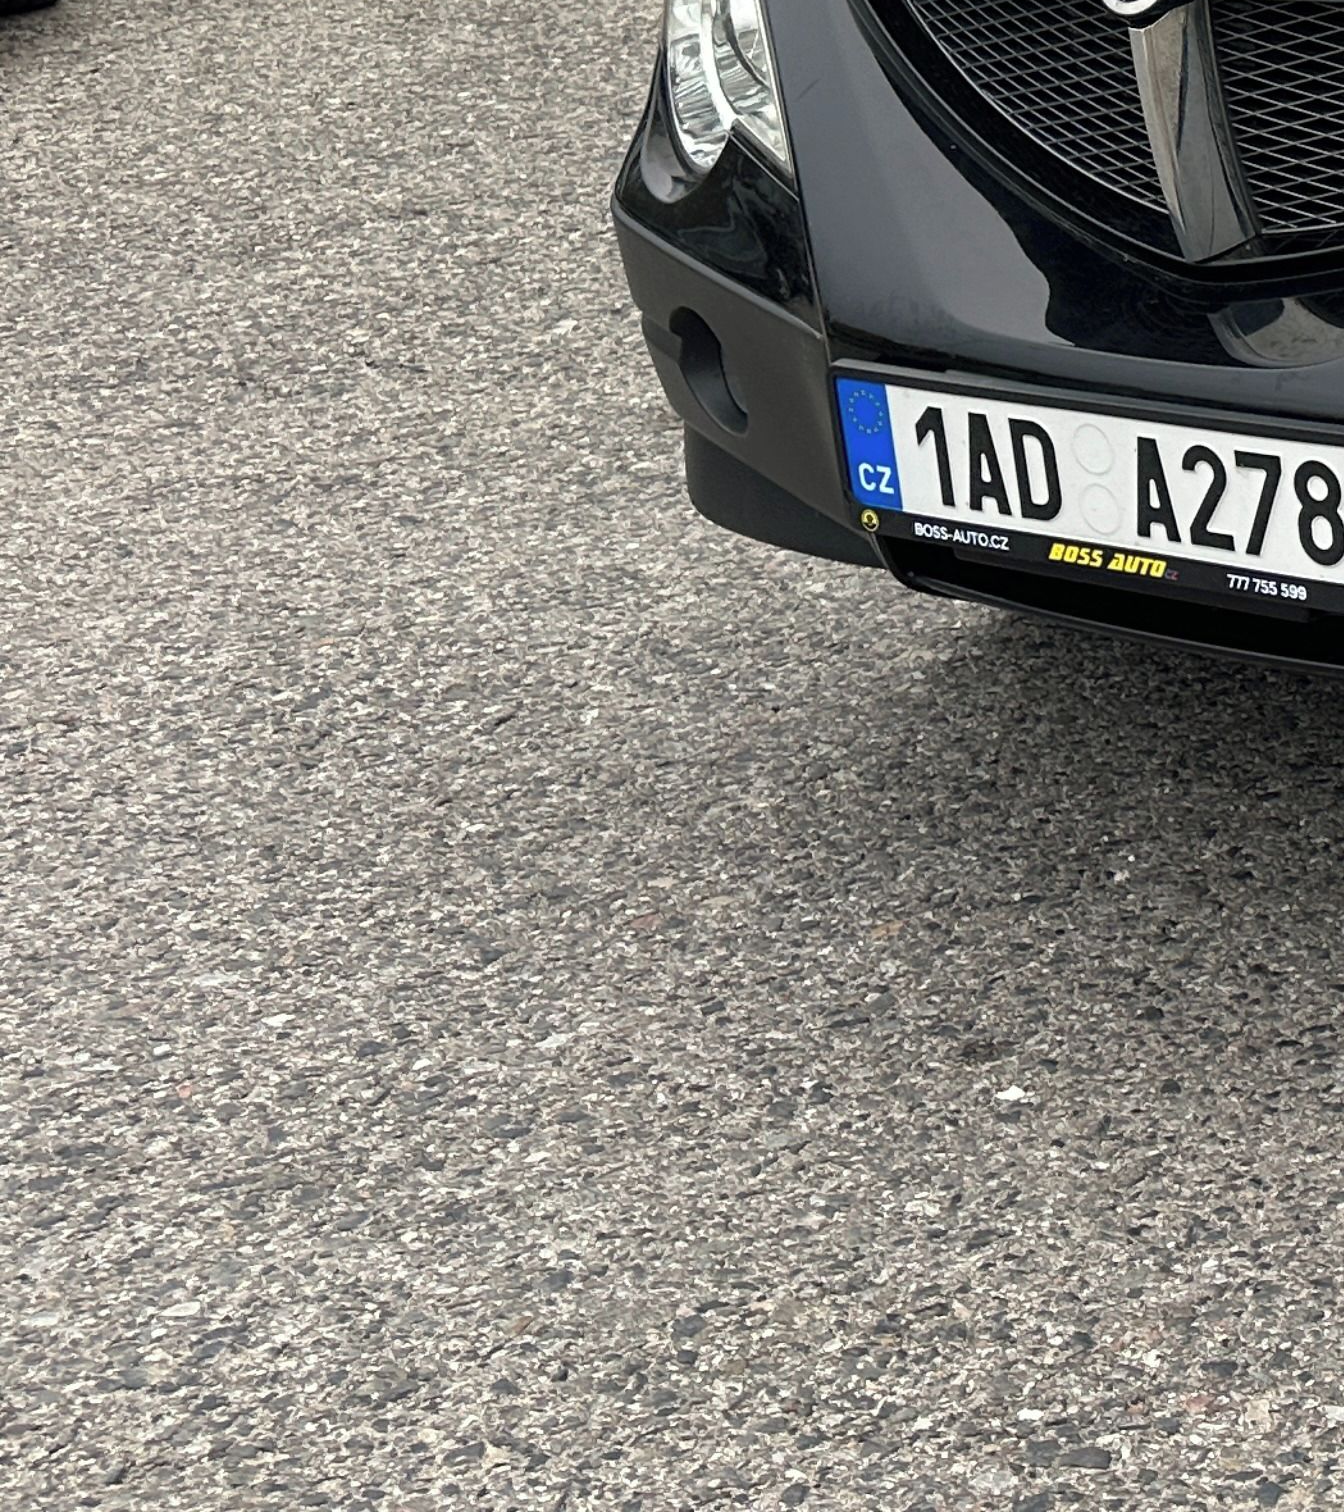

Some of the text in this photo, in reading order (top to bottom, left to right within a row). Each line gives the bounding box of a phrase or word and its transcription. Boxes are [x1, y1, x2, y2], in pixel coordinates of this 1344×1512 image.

[858, 462, 894, 495] CZ
[915, 405, 1063, 522] 1AD
[914, 521, 1010, 551] BOSS-AUTO.CZ
[1048, 542, 1103, 568] BOSS
[1107, 553, 1167, 579] AUTO
[1226, 573, 1308, 601] 777 755 599
